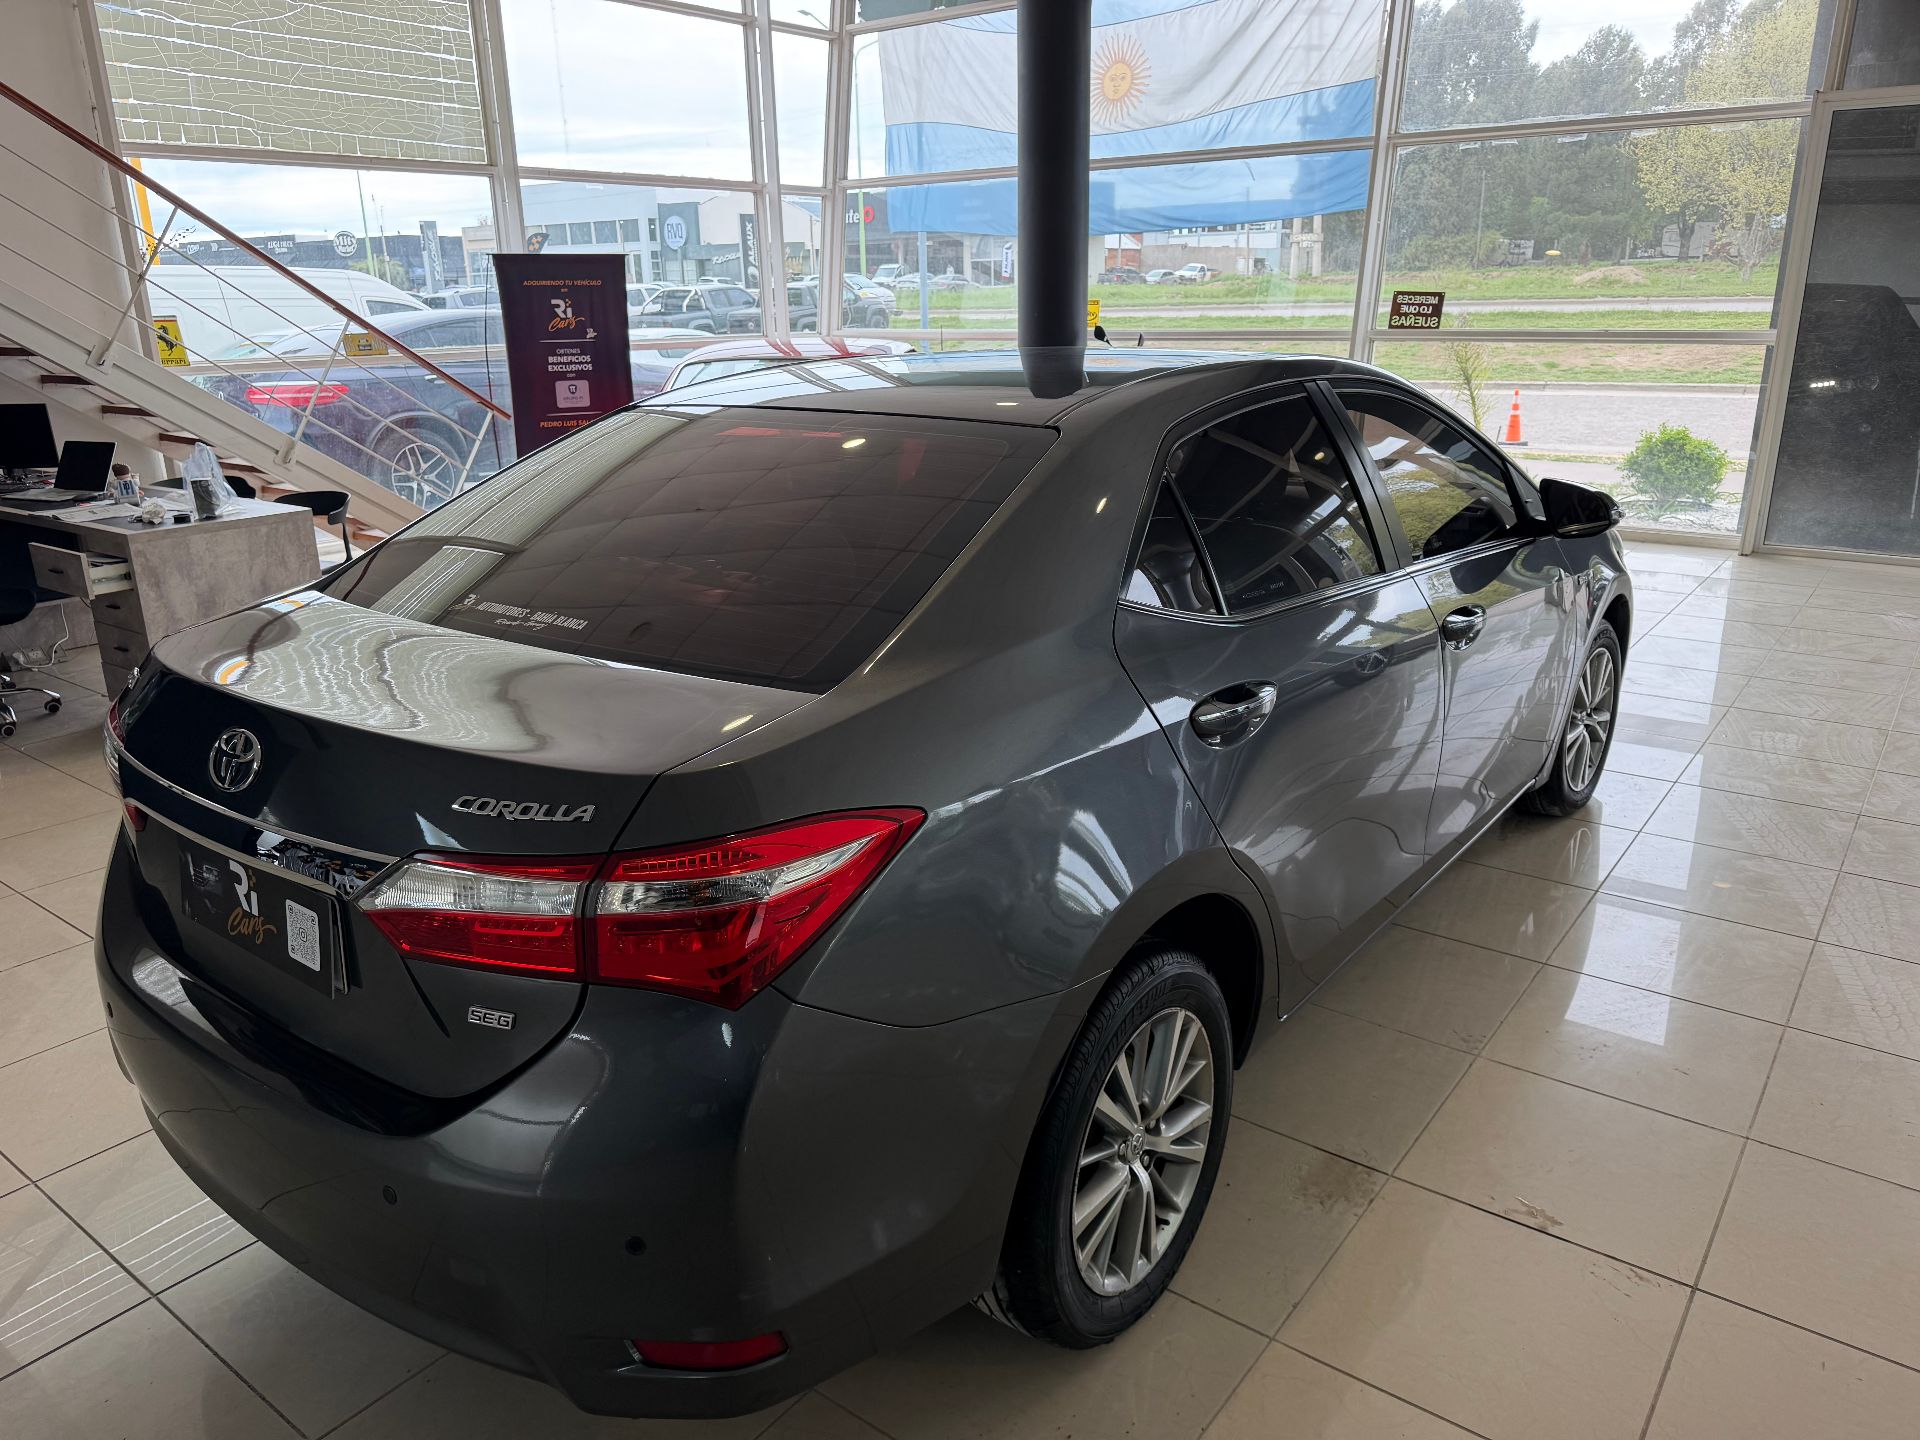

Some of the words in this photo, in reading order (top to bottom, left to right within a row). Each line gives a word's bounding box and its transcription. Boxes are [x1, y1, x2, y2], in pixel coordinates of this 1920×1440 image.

[548, 315, 585, 332] Cars
[547, 355, 592, 363] BENEFICIOS
[547, 363, 593, 372] EXCLUSIVOS
[475, 601, 531, 618] AUTOMOTORES
[553, 615, 589, 631] BLANCA
[451, 795, 596, 822] COROLLA
[227, 906, 278, 945] Cars
